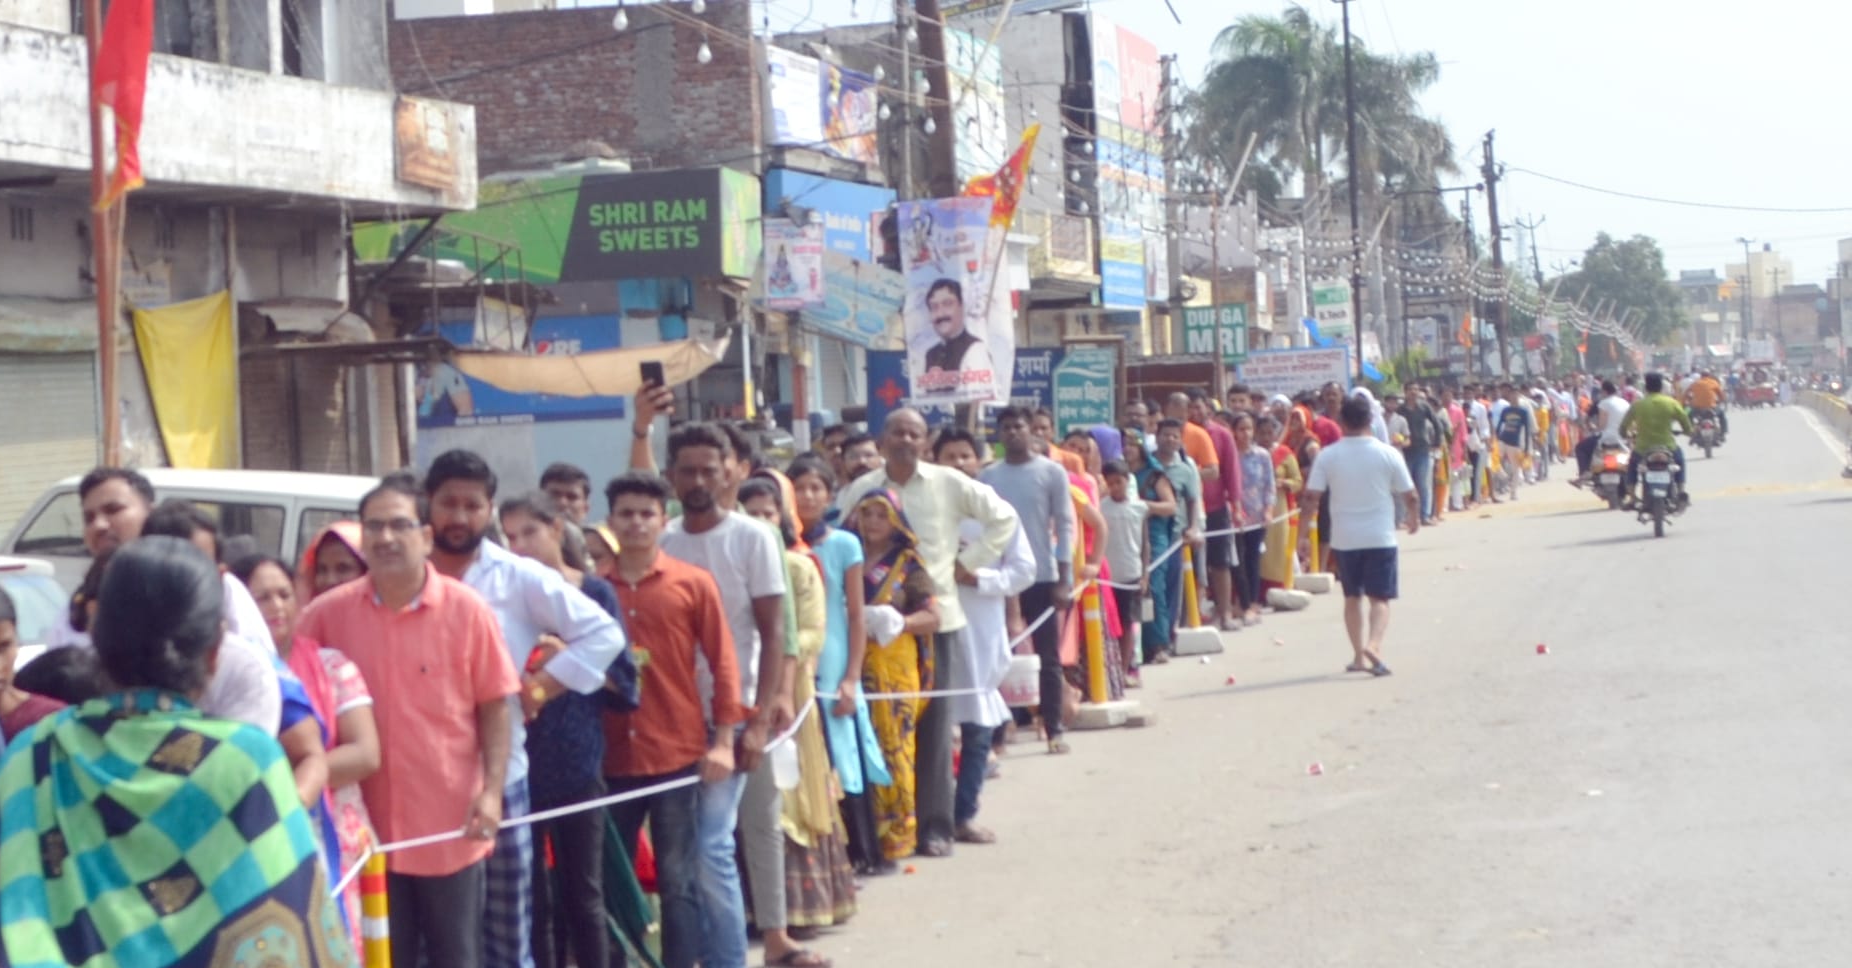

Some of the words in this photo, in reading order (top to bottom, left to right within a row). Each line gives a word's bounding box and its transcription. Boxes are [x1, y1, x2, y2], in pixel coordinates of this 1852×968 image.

[588, 200, 647, 227] SHRI
[652, 197, 708, 222] RAM
[599, 226, 700, 253] SWEETS
[1188, 327, 1245, 355] MRI
[1017, 352, 1053, 377] शर्मा
